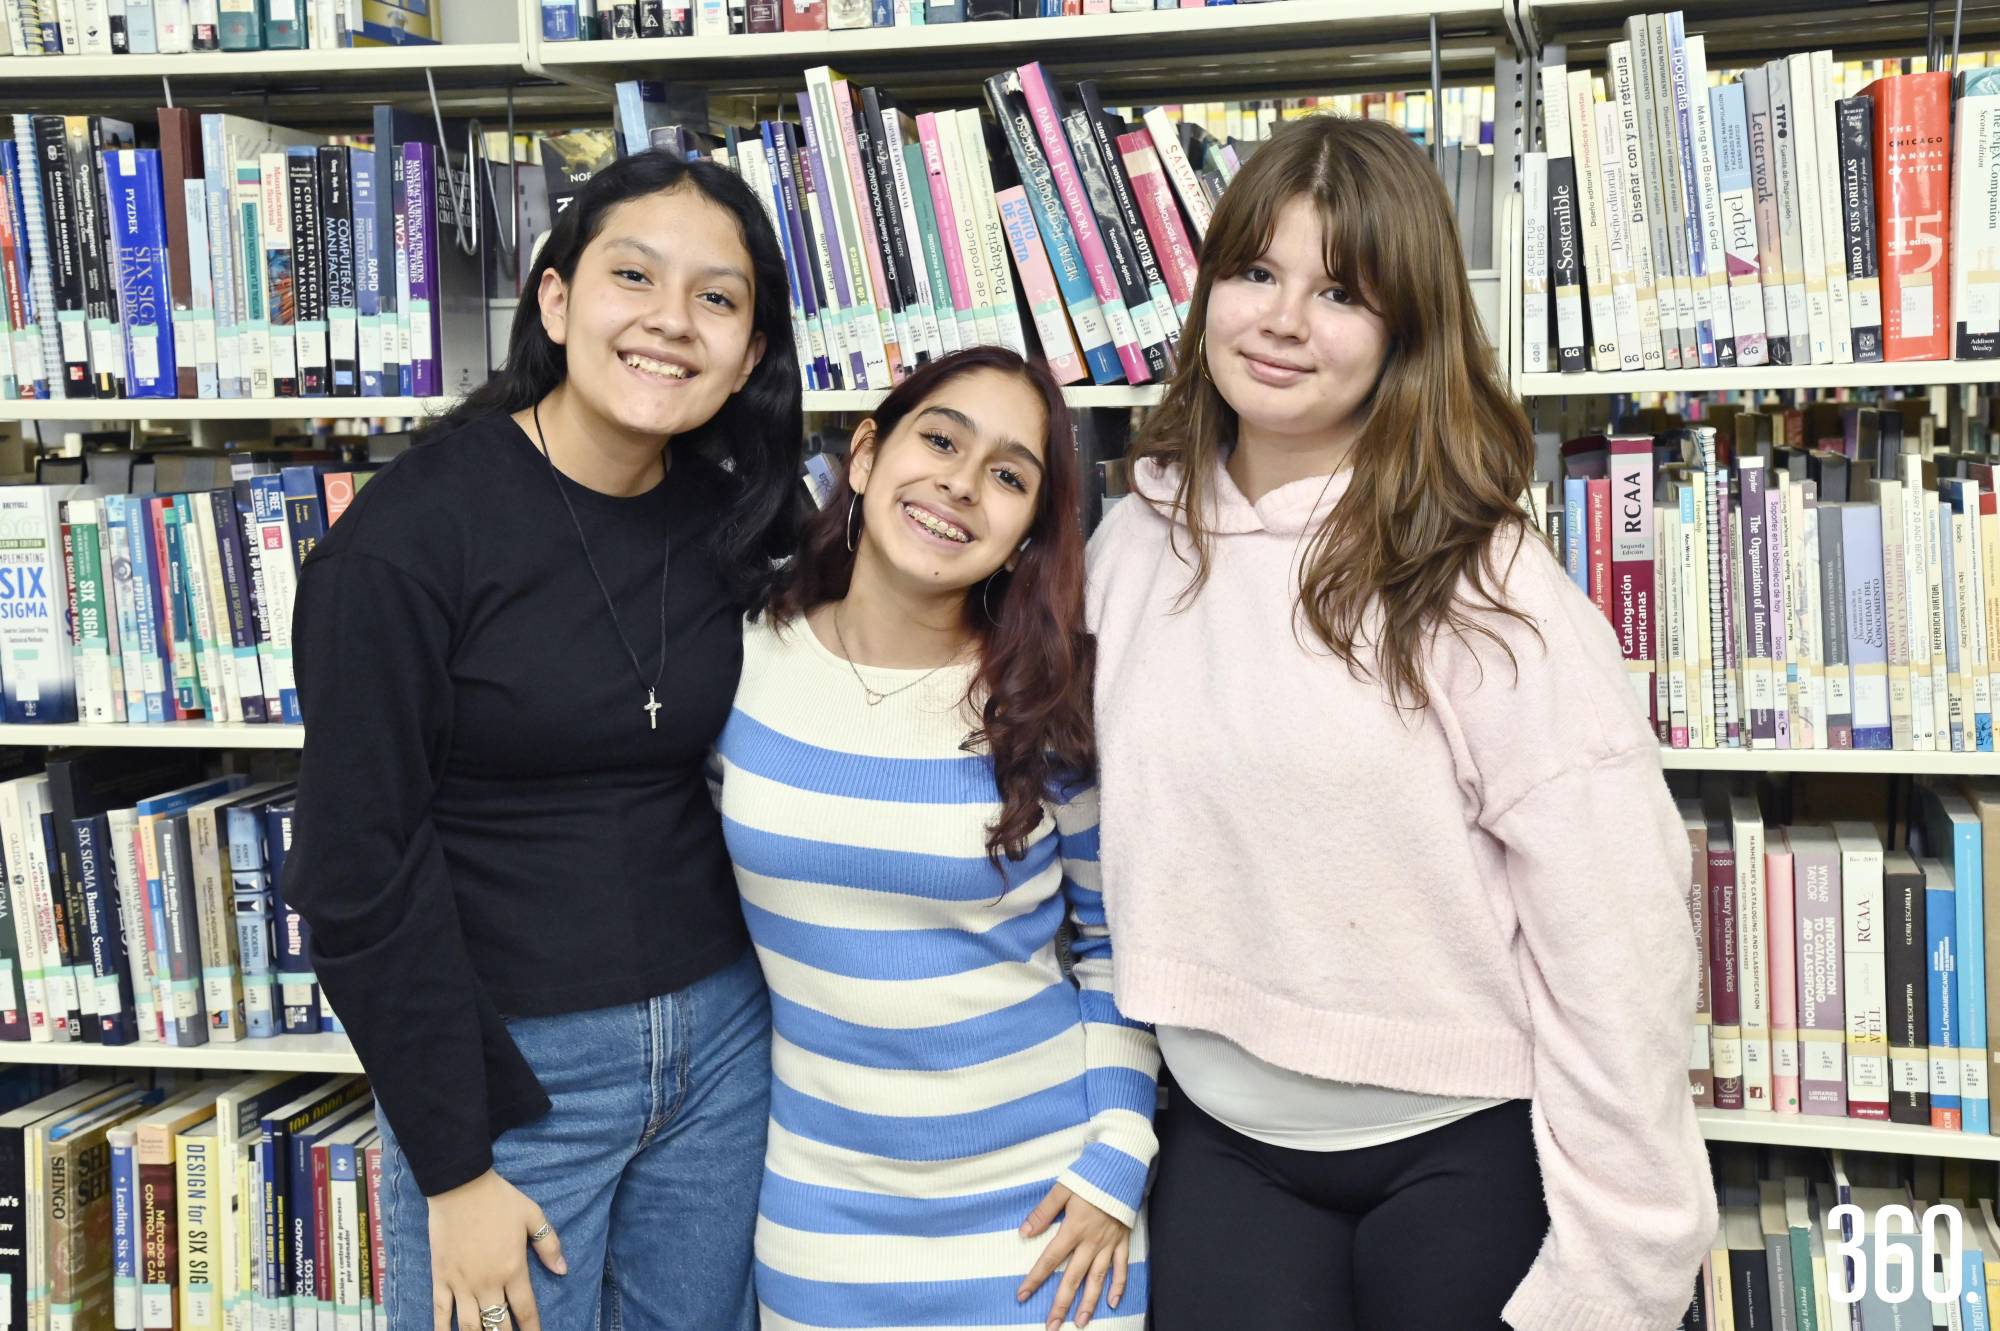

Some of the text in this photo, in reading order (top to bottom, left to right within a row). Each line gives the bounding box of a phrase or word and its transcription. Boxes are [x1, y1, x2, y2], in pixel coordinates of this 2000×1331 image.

[1657, 45, 1664, 53] EN
[1617, 56, 1633, 106] retícula
[1657, 55, 1667, 97] MOVIMIENTO
[1578, 93, 1587, 121] revistas
[1624, 108, 1635, 130] sin
[1582, 130, 1592, 168] Periódicos
[1628, 144, 1639, 168] con
[1751, 111, 1772, 204] Letterwork
[1889, 137, 1943, 146] CHICAGO
[1889, 151, 1943, 160] MANUAL
[1978, 110, 1988, 168] Second Edition
[894, 154, 909, 210] EXPERIMENTAL
[1038, 105, 1090, 243] PARQUE FUNDIDORA
[1585, 170, 1593, 200] editorial
[1696, 105, 1719, 250] Making and Breaking the Grid
[1782, 169, 1788, 178] de
[1848, 159, 1859, 207] ORILLAS
[1908, 164, 1943, 173] STYLE
[80, 164, 97, 257] Operations Management
[125, 188, 138, 234] PYZDEK
[267, 189, 275, 225] Survival
[273, 167, 284, 232] Manufacturing
[868, 167, 891, 255] del diseño PACKAGING
[1015, 114, 1079, 283] METAL Proceso
[1587, 202, 1597, 227] Diseño
[1605, 169, 1623, 251] Diseño editorial
[1629, 172, 1644, 223] Diseñar
[1987, 163, 1999, 230] Companion
[55, 171, 72, 276] OPERATIONS MANAGEMENT
[294, 187, 305, 261] DESIGN AND
[406, 160, 418, 283] SYSTEMS AND FACTORIES
[1001, 202, 1031, 264] DE VENTA
[1013, 197, 1038, 242] PUNTO
[1126, 209, 1156, 268] RELOJES Jean
[1527, 218, 1535, 240] TUS
[1554, 185, 1573, 269] Sostenible
[1725, 195, 1754, 250] papel
[1850, 211, 1859, 232] SUS
[134, 246, 152, 280] SIX
[355, 218, 366, 291] PROTOTYPING
[962, 217, 986, 297] de producto
[986, 216, 1008, 296] Packaging
[1106, 227, 1135, 286] Tecnología óptica
[1172, 243, 1184, 257] DE
[1537, 224, 1545, 266] LIBROS
[213, 257, 224, 277] Lean
[368, 258, 379, 291] RAPID
[823, 258, 836, 291] Cajas de
[849, 246, 865, 299] de la marca
[1564, 347, 1579, 358] GG
[1598, 343, 1615, 354] GG
[1744, 345, 1759, 355] GG
[269, 492, 280, 511] FREE
[1624, 472, 1641, 533] RCAA
[1749, 471, 1758, 493] Taylor
[1911, 479, 1919, 508] LIBRARY
[1770, 501, 1779, 531] Soportes
[1772, 533, 1778, 541] en
[0, 566, 46, 598] SIX
[66, 557, 76, 590] SIGMA
[243, 512, 270, 632] mejoramiento de la calidad
[1595, 563, 1604, 603] Memoirs of
[1751, 515, 1765, 609] The Organization of
[1772, 553, 1782, 584] biblioteca
[1, 602, 48, 618] SIGMA
[70, 592, 78, 611] FOR
[80, 580, 94, 602] SIX
[133, 576, 145, 611] Calidad
[1772, 601, 1782, 613] hoy
[1773, 587, 1782, 598] de
[1621, 574, 1634, 654] Catalogación
[1636, 591, 1648, 660] americanas
[1932, 584, 1941, 650] REFERENCIA VIRTUAL
[77, 827, 100, 934] SIX SIGMA Business
[131, 877, 141, 901] TOTAL
[162, 834, 177, 917] Management Quality
[1806, 866, 1817, 900] TAYLOR
[1818, 866, 1829, 902] WYNAR
[1751, 887, 1759, 932] CATALOGING
[1857, 900, 1872, 943] RCAA
[241, 926, 249, 968] INDUSTRIAL
[250, 925, 259, 957] MODERN
[286, 914, 301, 955] Quality
[1723, 886, 1735, 992] Library Technical Services
[1803, 918, 1815, 1026] AND CLASSIFICATION
[1815, 917, 1826, 1003] TO CATALOGING
[1826, 917, 1836, 995] INTRODUCTION
[1753, 951, 1761, 1010] CLASSIFICATION
[51, 1157, 65, 1219] SHINGO
[187, 1145, 208, 1256] DESIGN for SIX
[115, 1188, 129, 1258] Leading Six
[144, 1184, 156, 1256] CONTROL DE
[337, 1233, 343, 1241] de
[360, 1249, 369, 1278] SCADA
